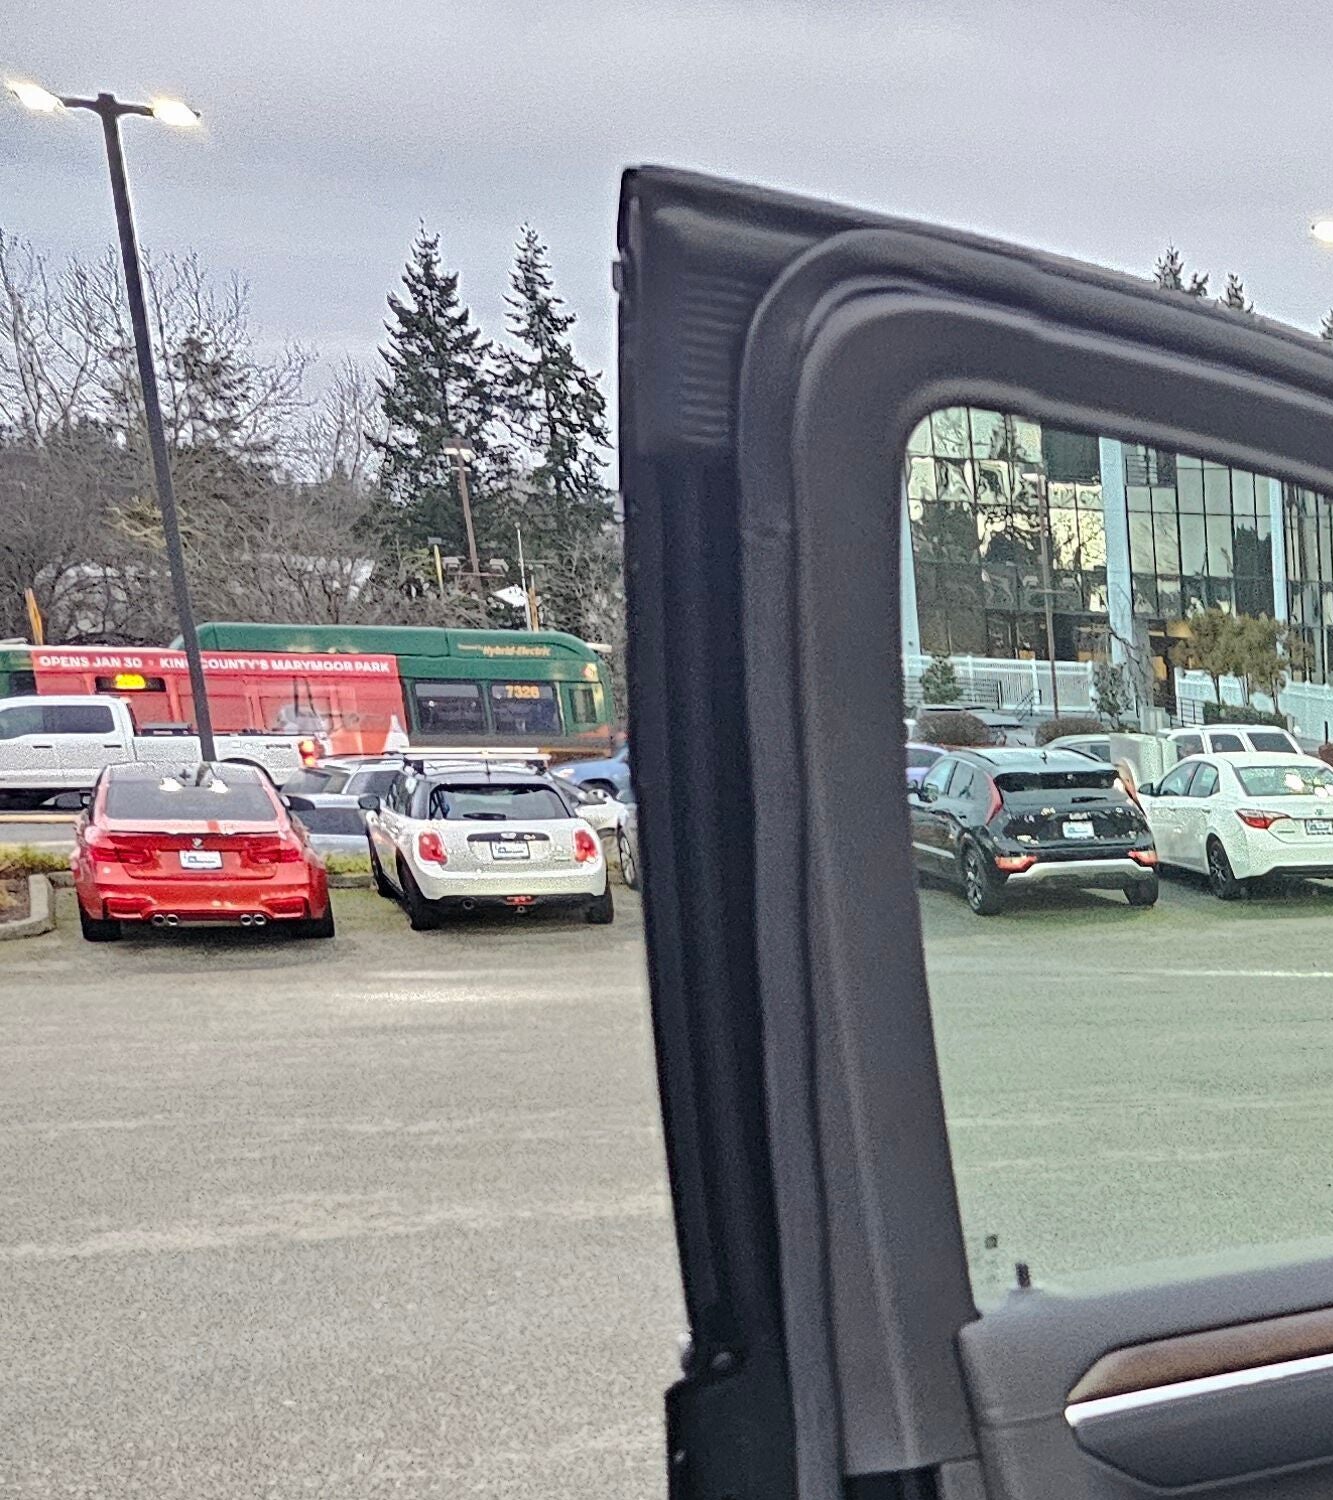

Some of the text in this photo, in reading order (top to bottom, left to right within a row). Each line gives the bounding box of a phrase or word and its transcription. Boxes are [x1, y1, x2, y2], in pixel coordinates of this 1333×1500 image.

[39, 655, 90, 668] OPENS
[92, 655, 122, 668] JAN
[124, 656, 143, 668] 30
[201, 657, 269, 671] COUNTY'S
[271, 659, 353, 672] MARYMOOR
[355, 661, 390, 673] PARK
